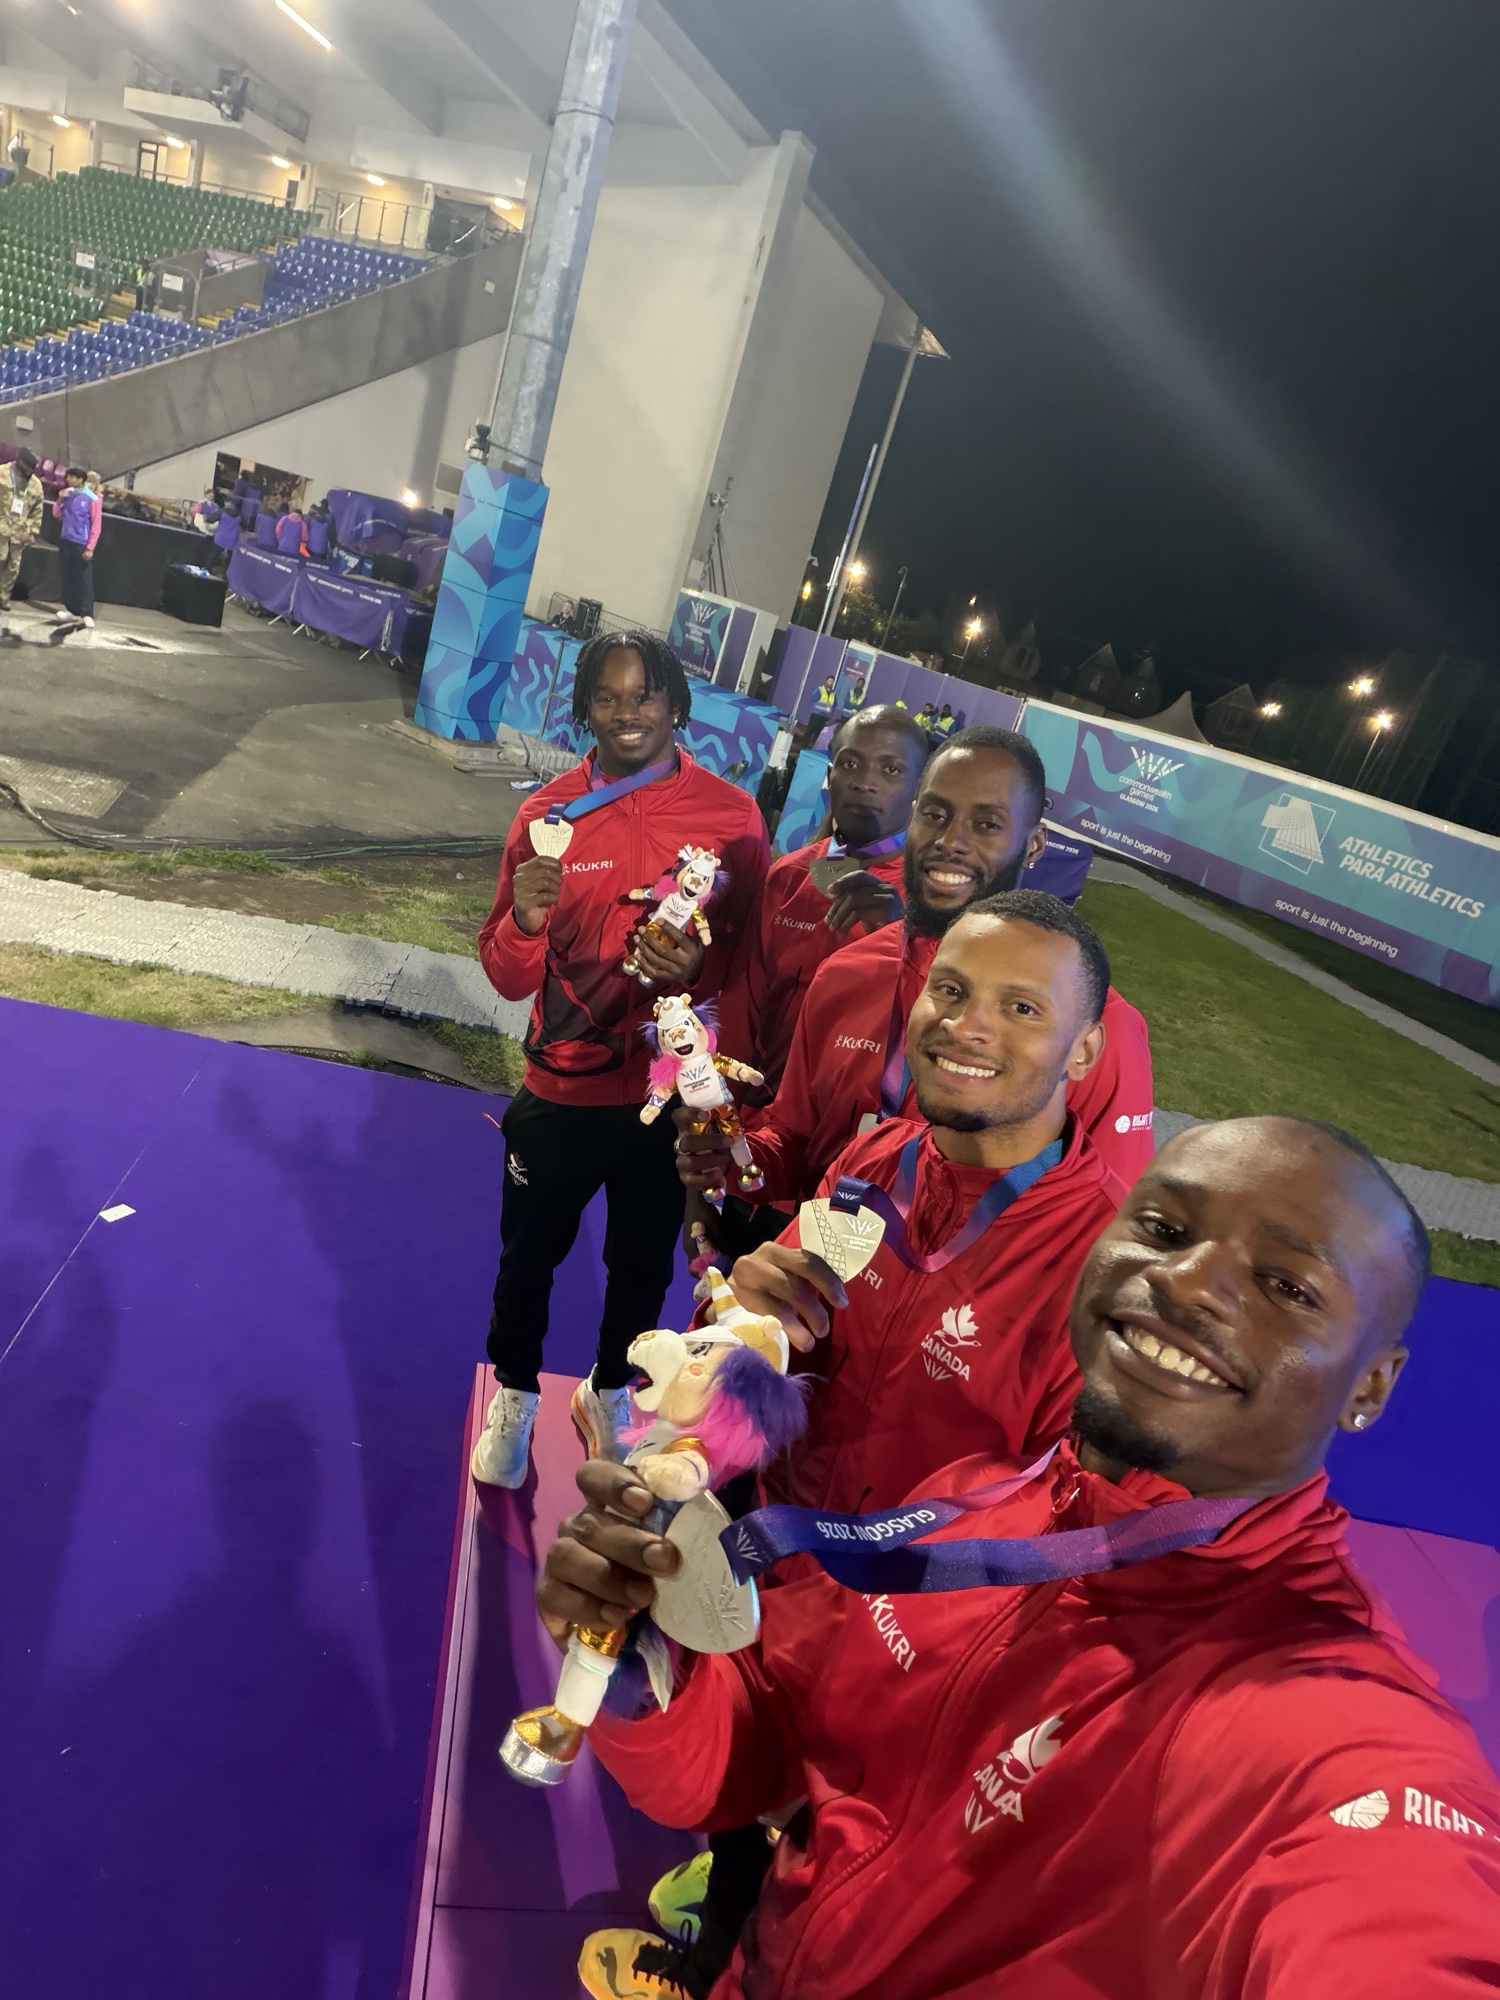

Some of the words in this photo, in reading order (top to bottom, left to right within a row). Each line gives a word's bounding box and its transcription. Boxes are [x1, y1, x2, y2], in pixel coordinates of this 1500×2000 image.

[1119, 776, 1172, 799] commonwealth
[1129, 788, 1155, 801] games
[1119, 793, 1146, 808] GLASGOW
[1144, 802, 1159, 813] 2026
[1080, 818, 1100, 832] sport
[1100, 825, 1107, 835] is
[1106, 828, 1122, 841] just
[1121, 834, 1134, 846] the
[1134, 839, 1172, 864] beginning
[572, 860, 613, 873] KUKRI
[1338, 836, 1434, 879] ATHLETICS
[1339, 854, 1385, 882] PARA
[1384, 871, 1486, 918] ATHLETICS
[782, 916, 816, 931] KUKRI
[1275, 899, 1301, 916] sport
[1301, 908, 1311, 920] is
[1309, 912, 1330, 929] just
[1329, 921, 1347, 936] the
[1346, 927, 1399, 959] beginning
[841, 1036, 881, 1054] KUKRI
[816, 1521, 856, 1539] 2026
[853, 1509, 937, 1541] GLASGOW
[868, 1593, 917, 1673] KUKRI
[1404, 1786, 1487, 1837] RIGHT
